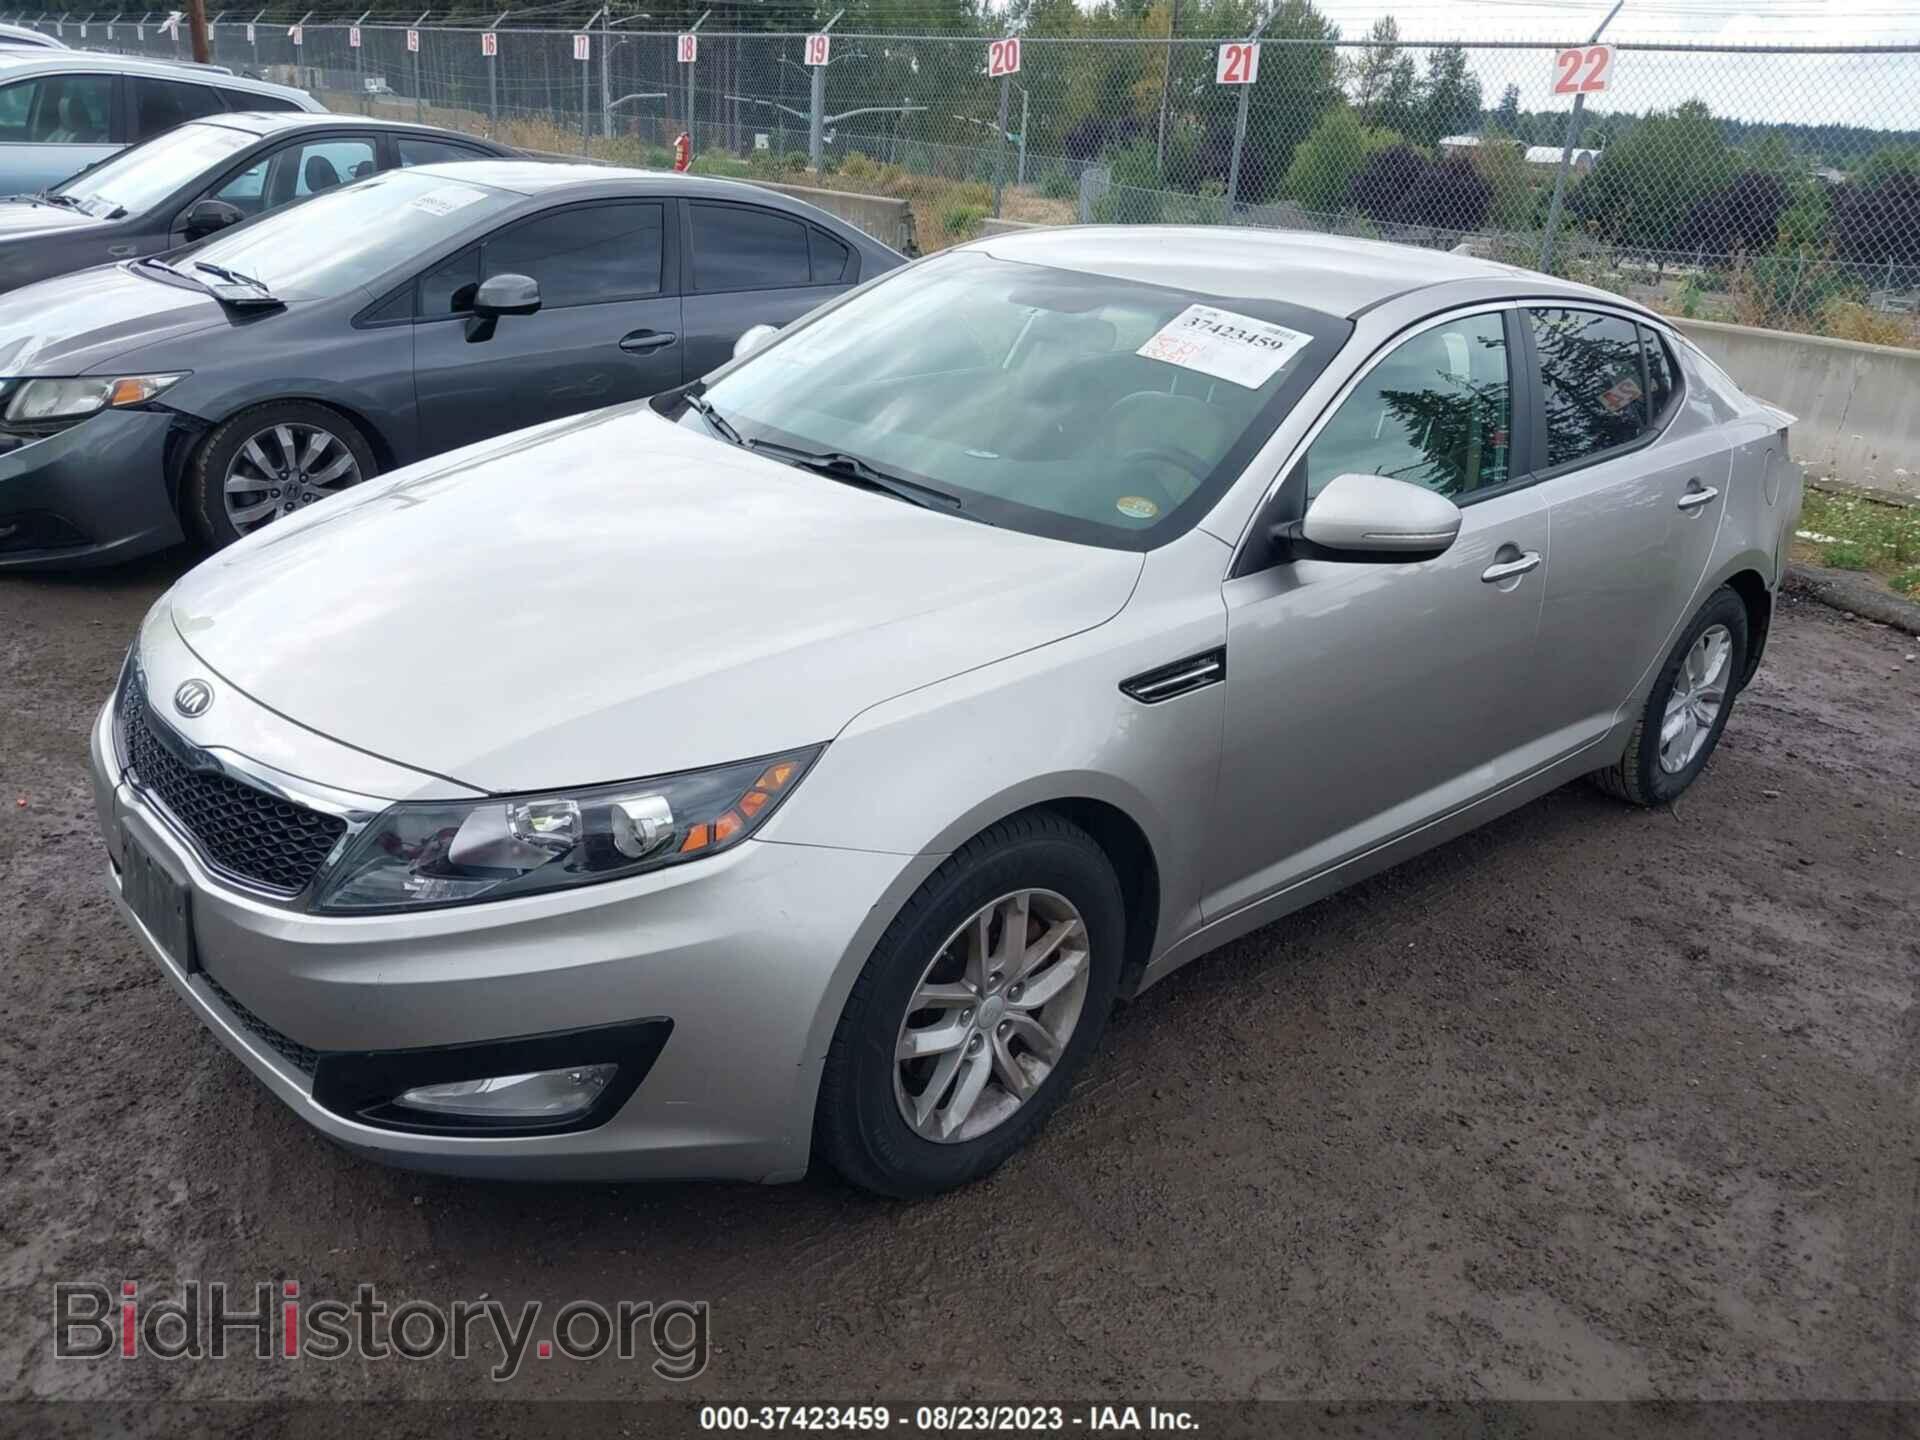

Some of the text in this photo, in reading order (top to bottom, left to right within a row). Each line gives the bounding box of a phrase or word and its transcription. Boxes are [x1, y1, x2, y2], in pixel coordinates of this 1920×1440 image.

[409, 31, 417, 49] 15
[484, 35, 496, 54] 16
[577, 36, 586, 59] 17
[682, 36, 693, 60] 18
[810, 37, 826, 64] 19
[991, 40, 1018, 74] 20
[1223, 45, 1252, 81] 21
[1555, 46, 1609, 93] 22
[1183, 316, 1284, 351] 37423459
